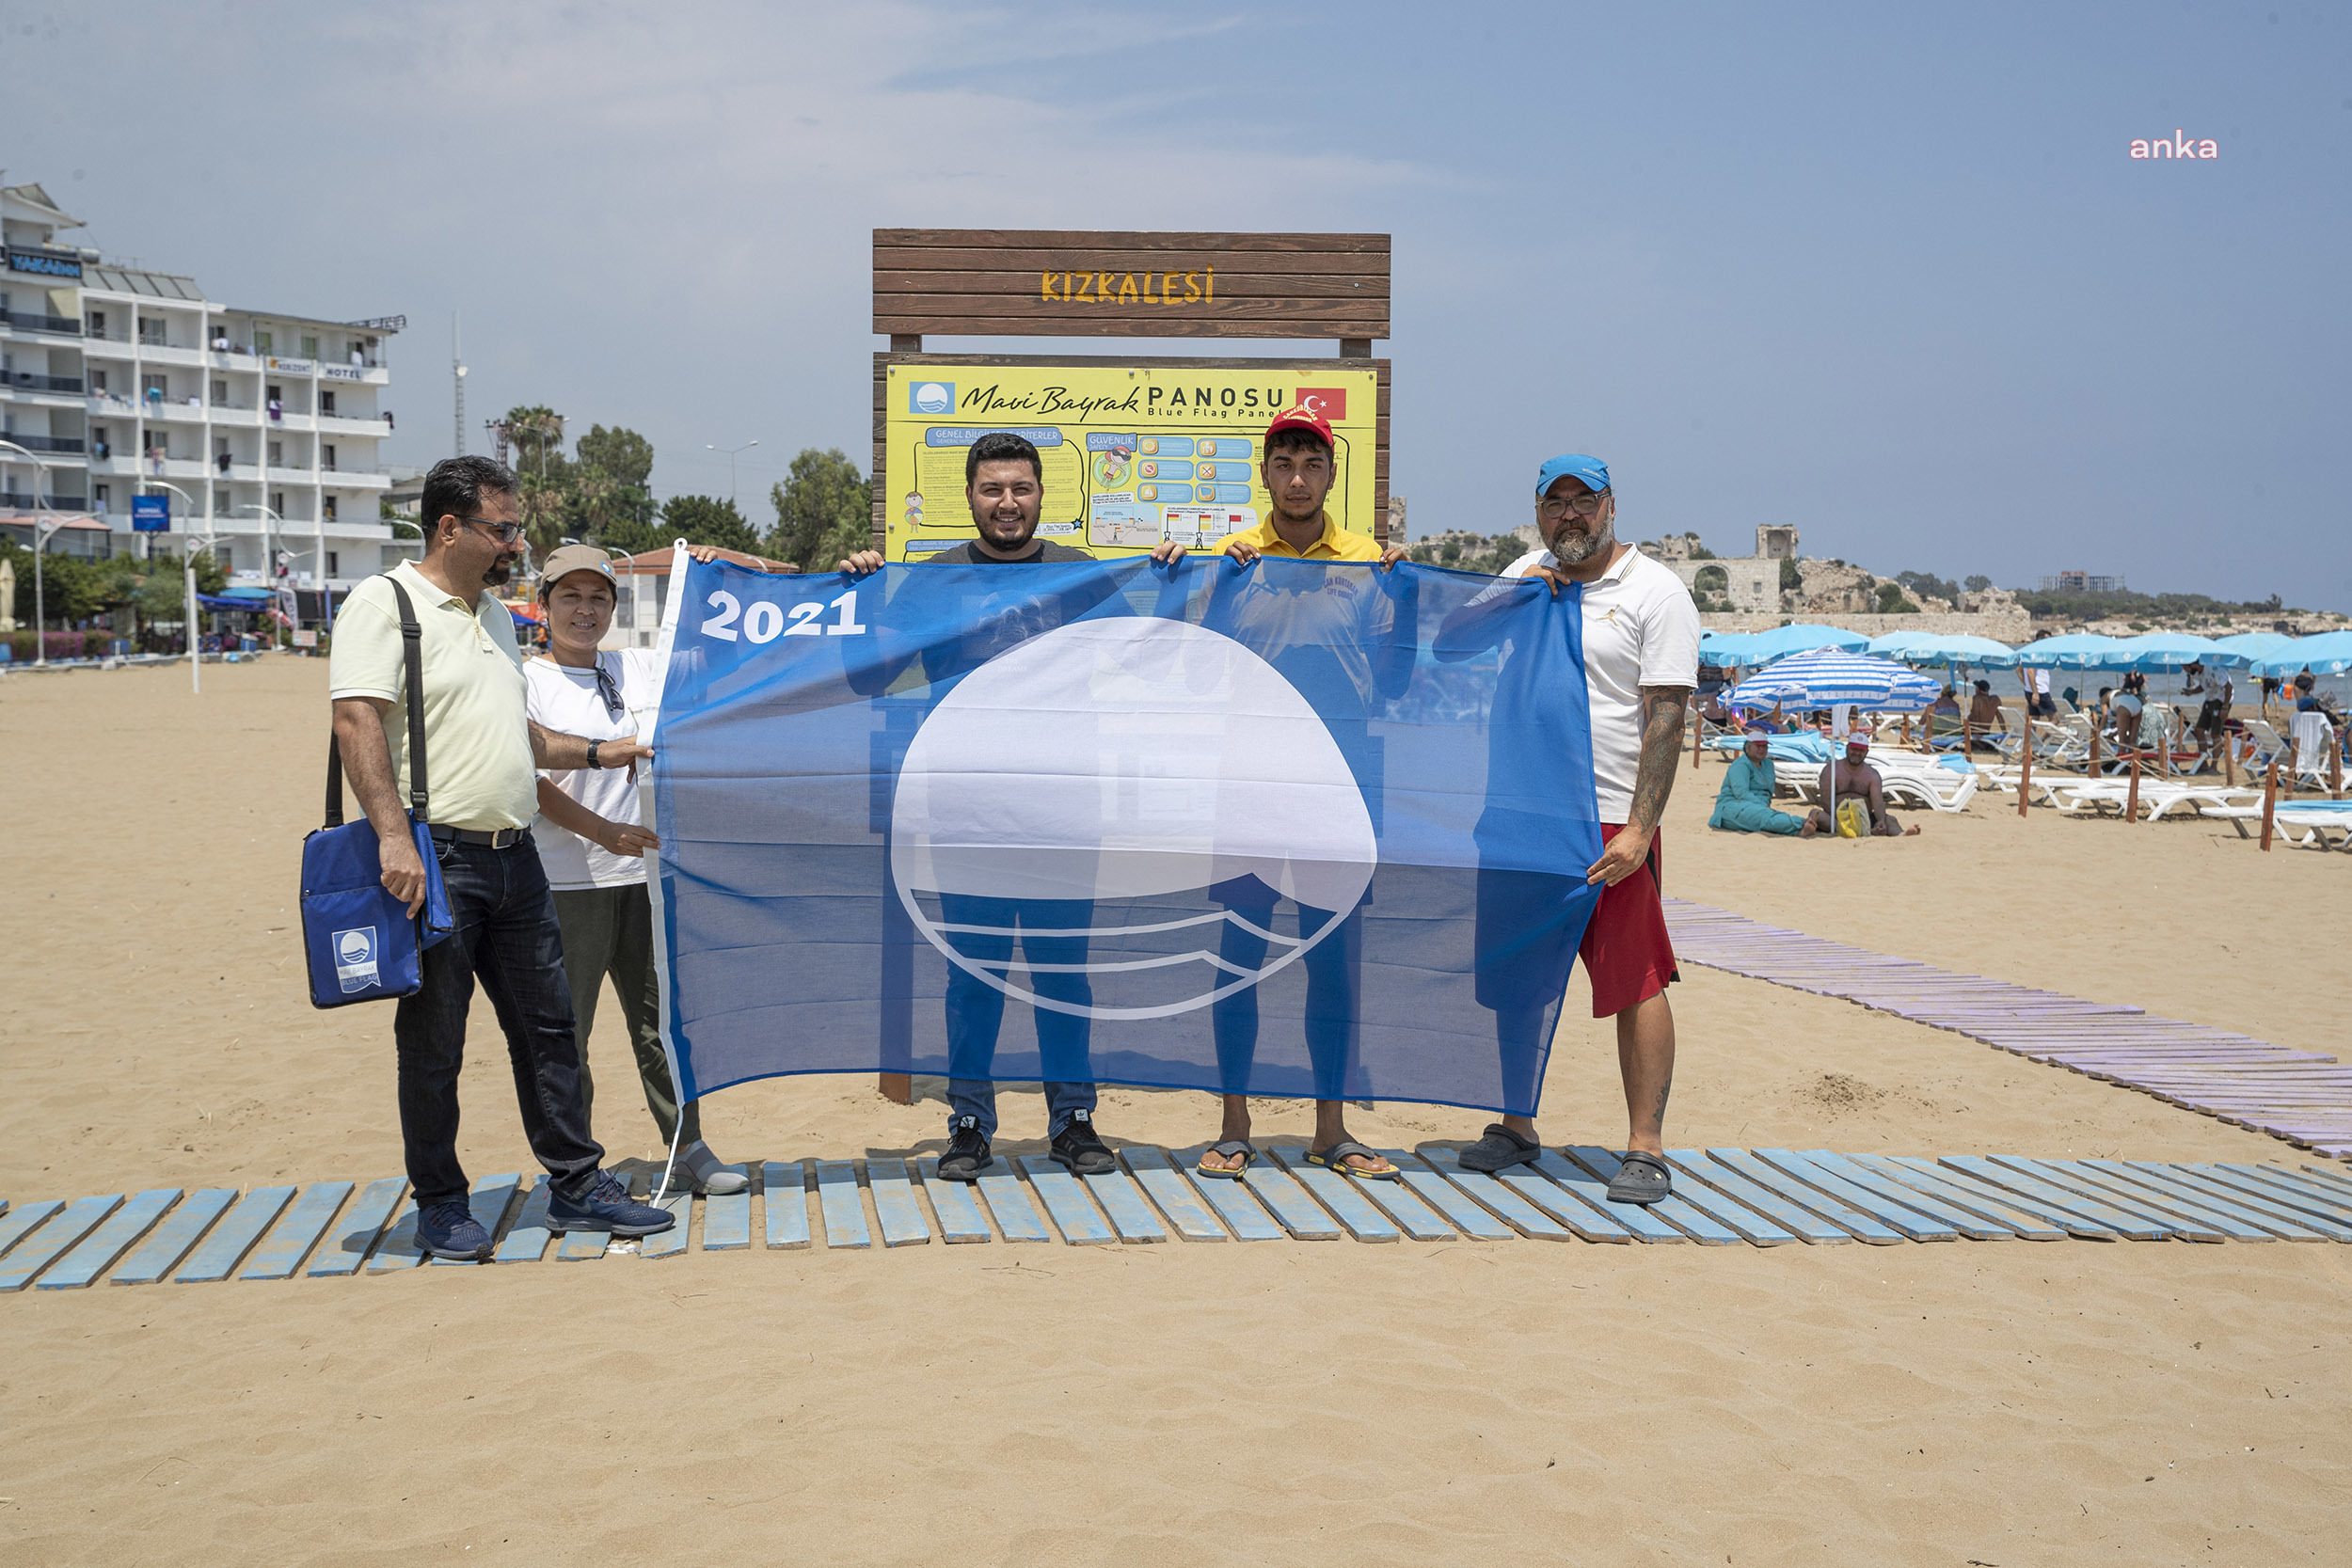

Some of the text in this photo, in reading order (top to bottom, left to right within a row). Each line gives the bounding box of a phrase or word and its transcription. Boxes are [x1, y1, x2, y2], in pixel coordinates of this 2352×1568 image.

[1041, 263, 1214, 305] KIZKALESİ
[326, 368, 360, 379] HOTEL
[961, 384, 1282, 422] Mavi Bayrak PANOSU
[1148, 407, 1183, 416] Blue
[1193, 408, 1227, 419] Flag
[935, 429, 963, 438] GENEL
[965, 428, 1000, 439] BİLGİ
[1089, 435, 1133, 445] GÜVENLİK
[700, 589, 866, 644] 2021
[342, 977, 358, 986] BLUE
